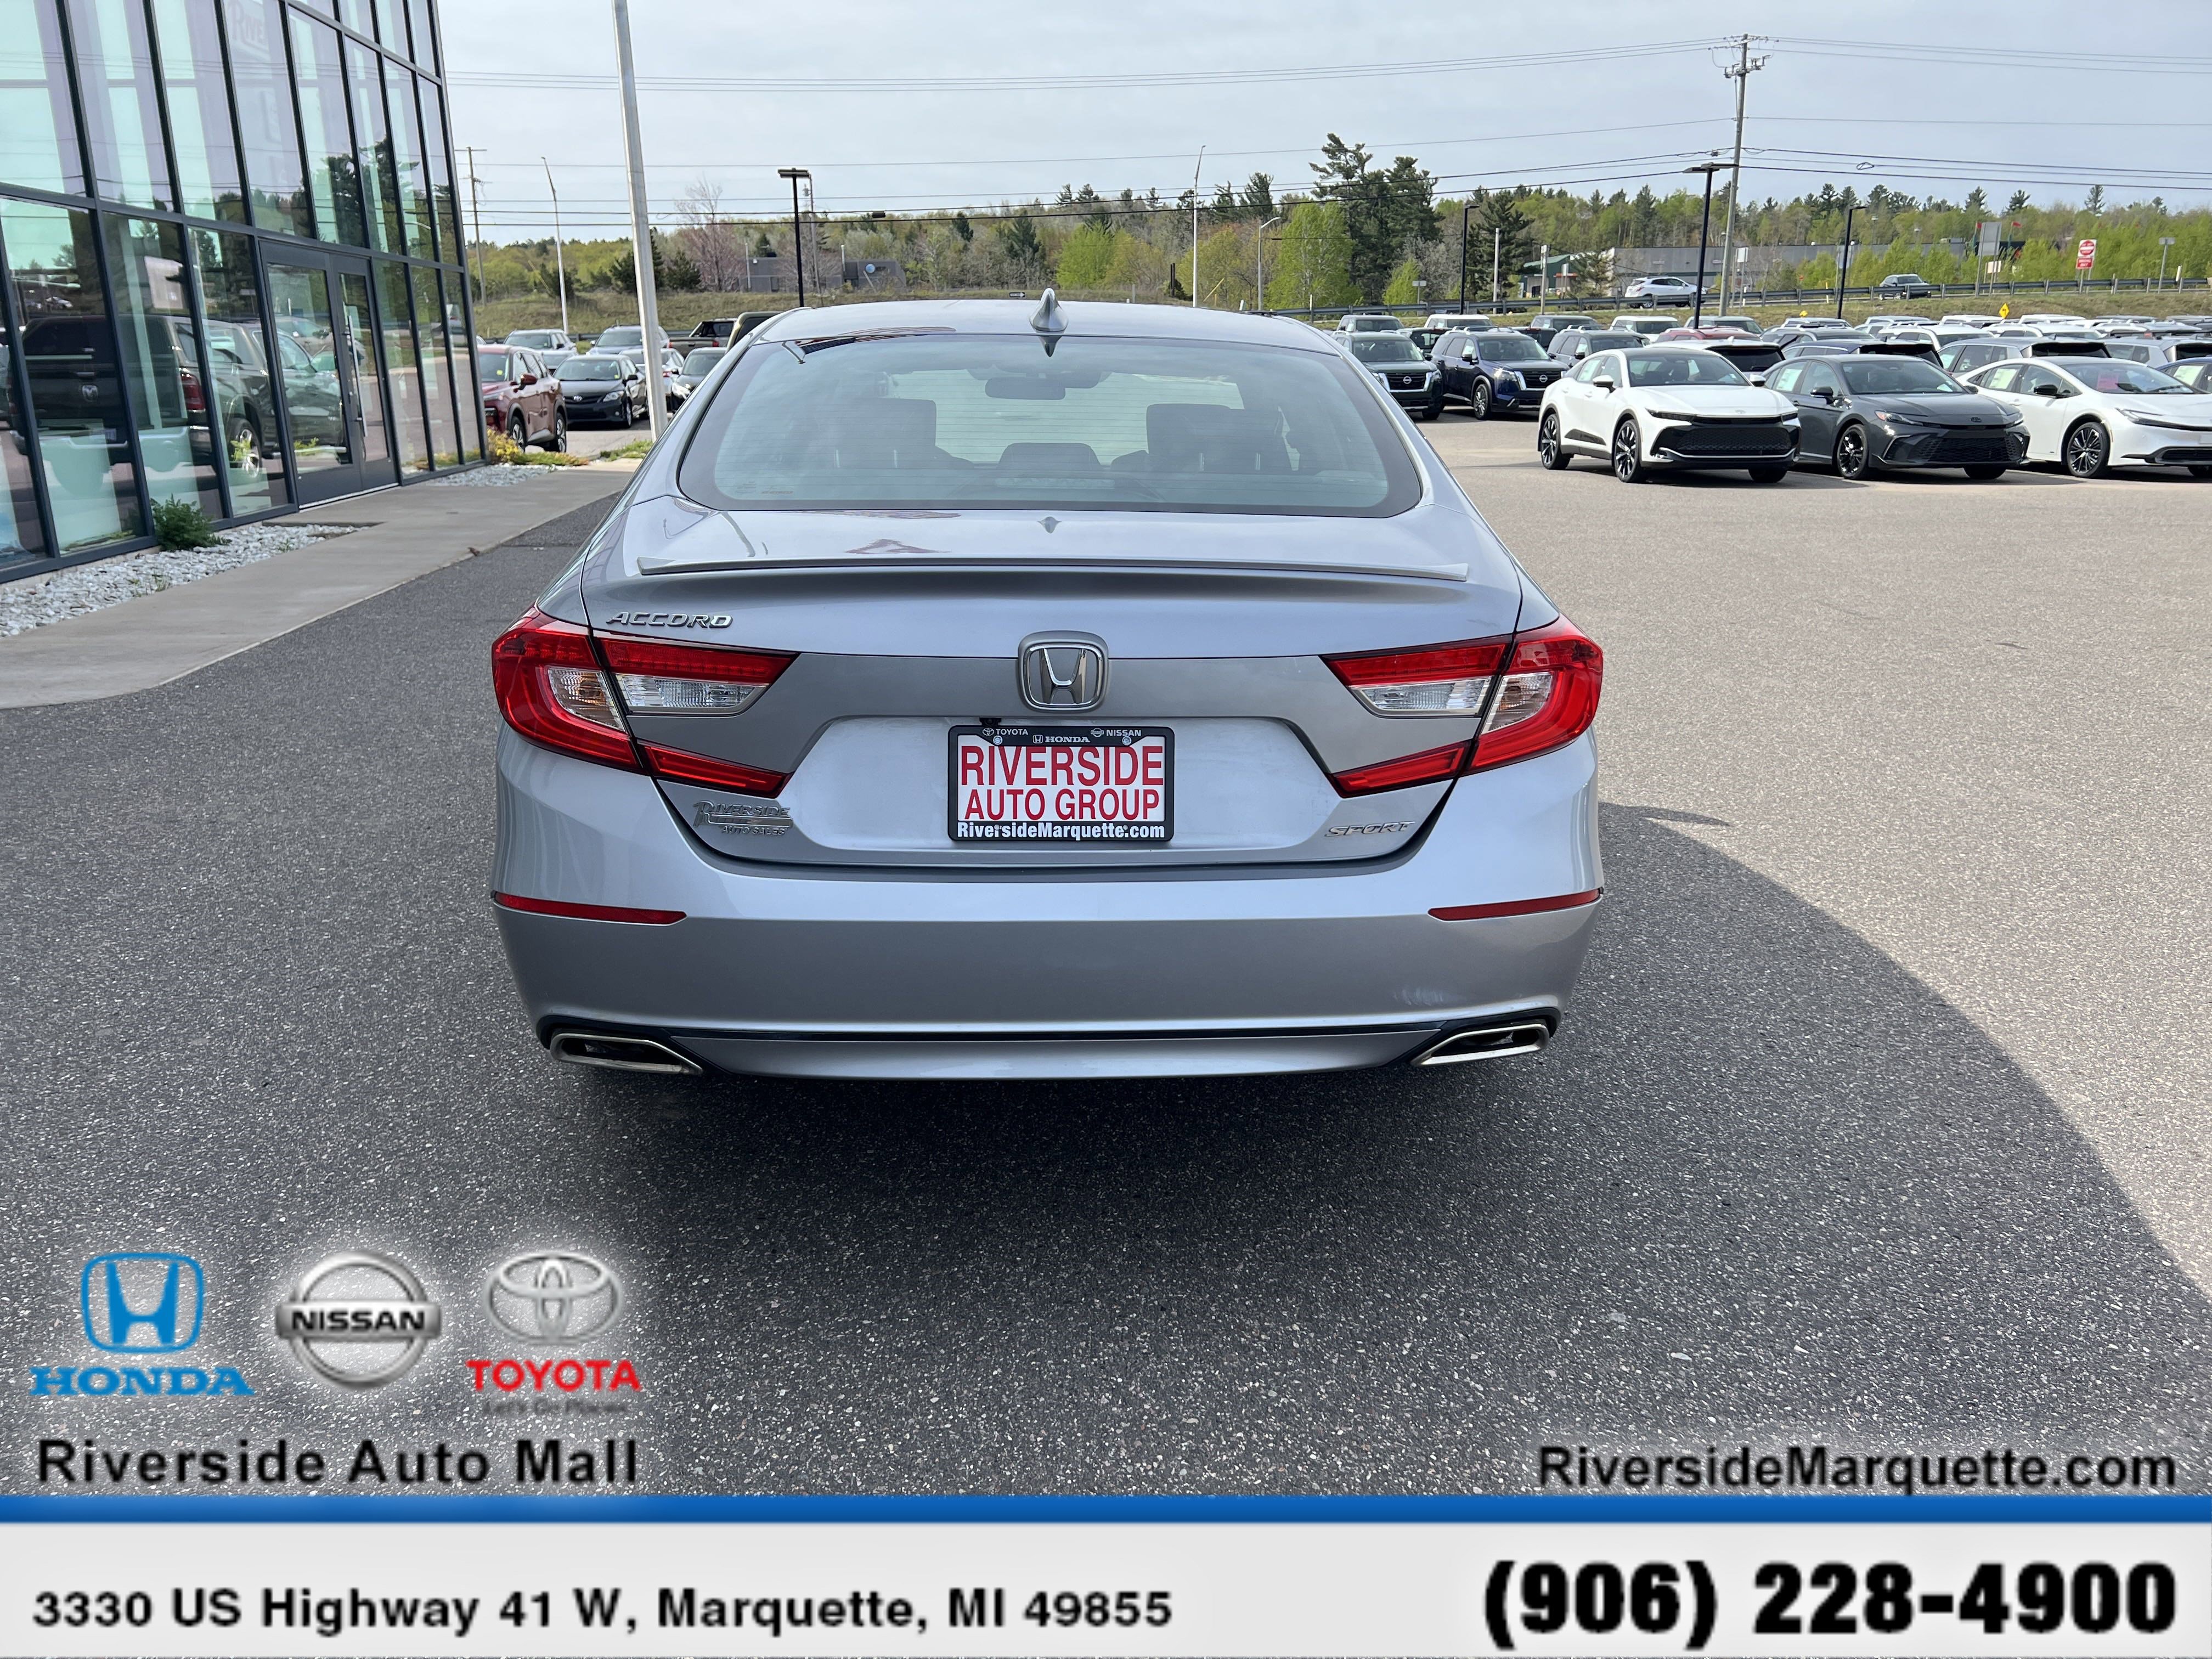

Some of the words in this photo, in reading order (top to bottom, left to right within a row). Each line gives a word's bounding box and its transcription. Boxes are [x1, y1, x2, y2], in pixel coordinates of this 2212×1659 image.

[606, 611, 733, 629] ACCORD
[961, 746, 1164, 786] RIVERSIDE
[964, 788, 1046, 820] AUTO
[1055, 788, 1159, 821] GROUP
[722, 826, 750, 834] AUTO
[752, 827, 787, 836] SALES
[957, 822, 1165, 841] RiversideMarquette.com
[1325, 821, 1416, 838] SPORT
